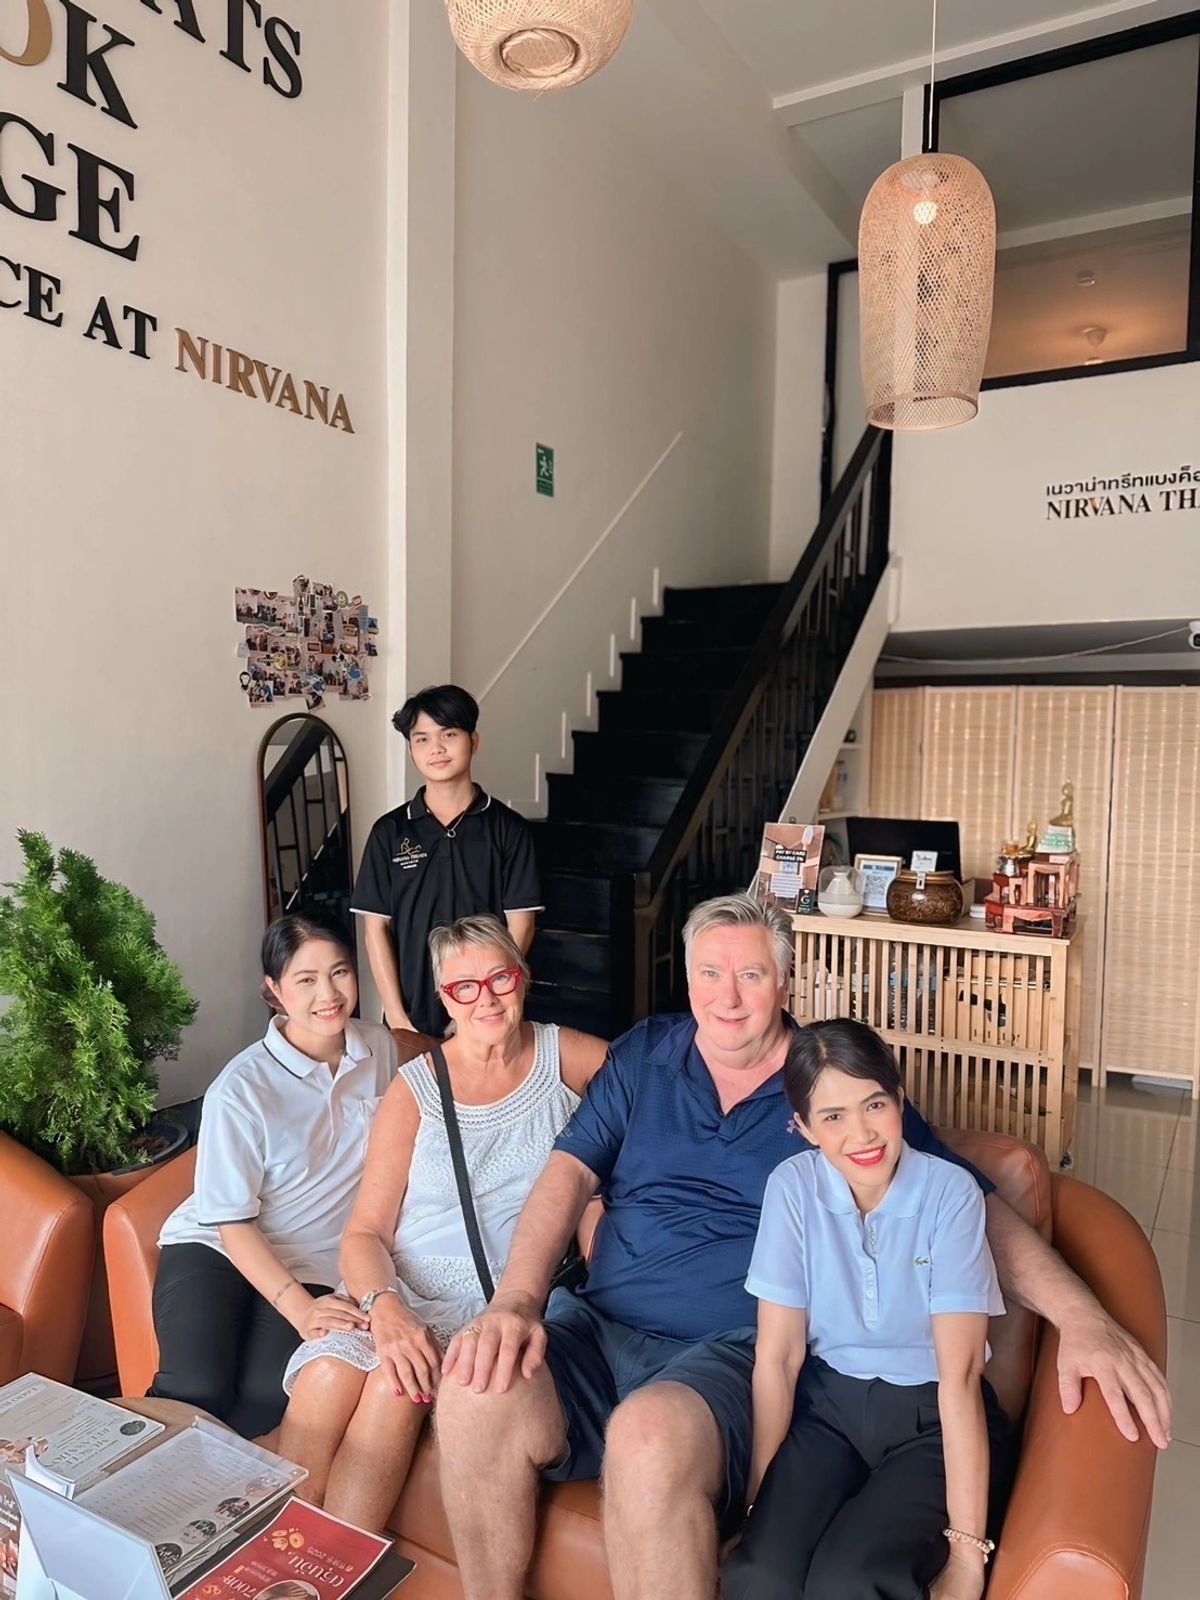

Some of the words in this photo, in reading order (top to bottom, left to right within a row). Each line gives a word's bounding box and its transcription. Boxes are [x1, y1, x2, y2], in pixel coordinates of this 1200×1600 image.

[83, 296, 157, 360] AT
[174, 327, 355, 434] NIRVANA
[1046, 493, 1152, 520] NIRVANA
[1159, 488, 1200, 512] TH
